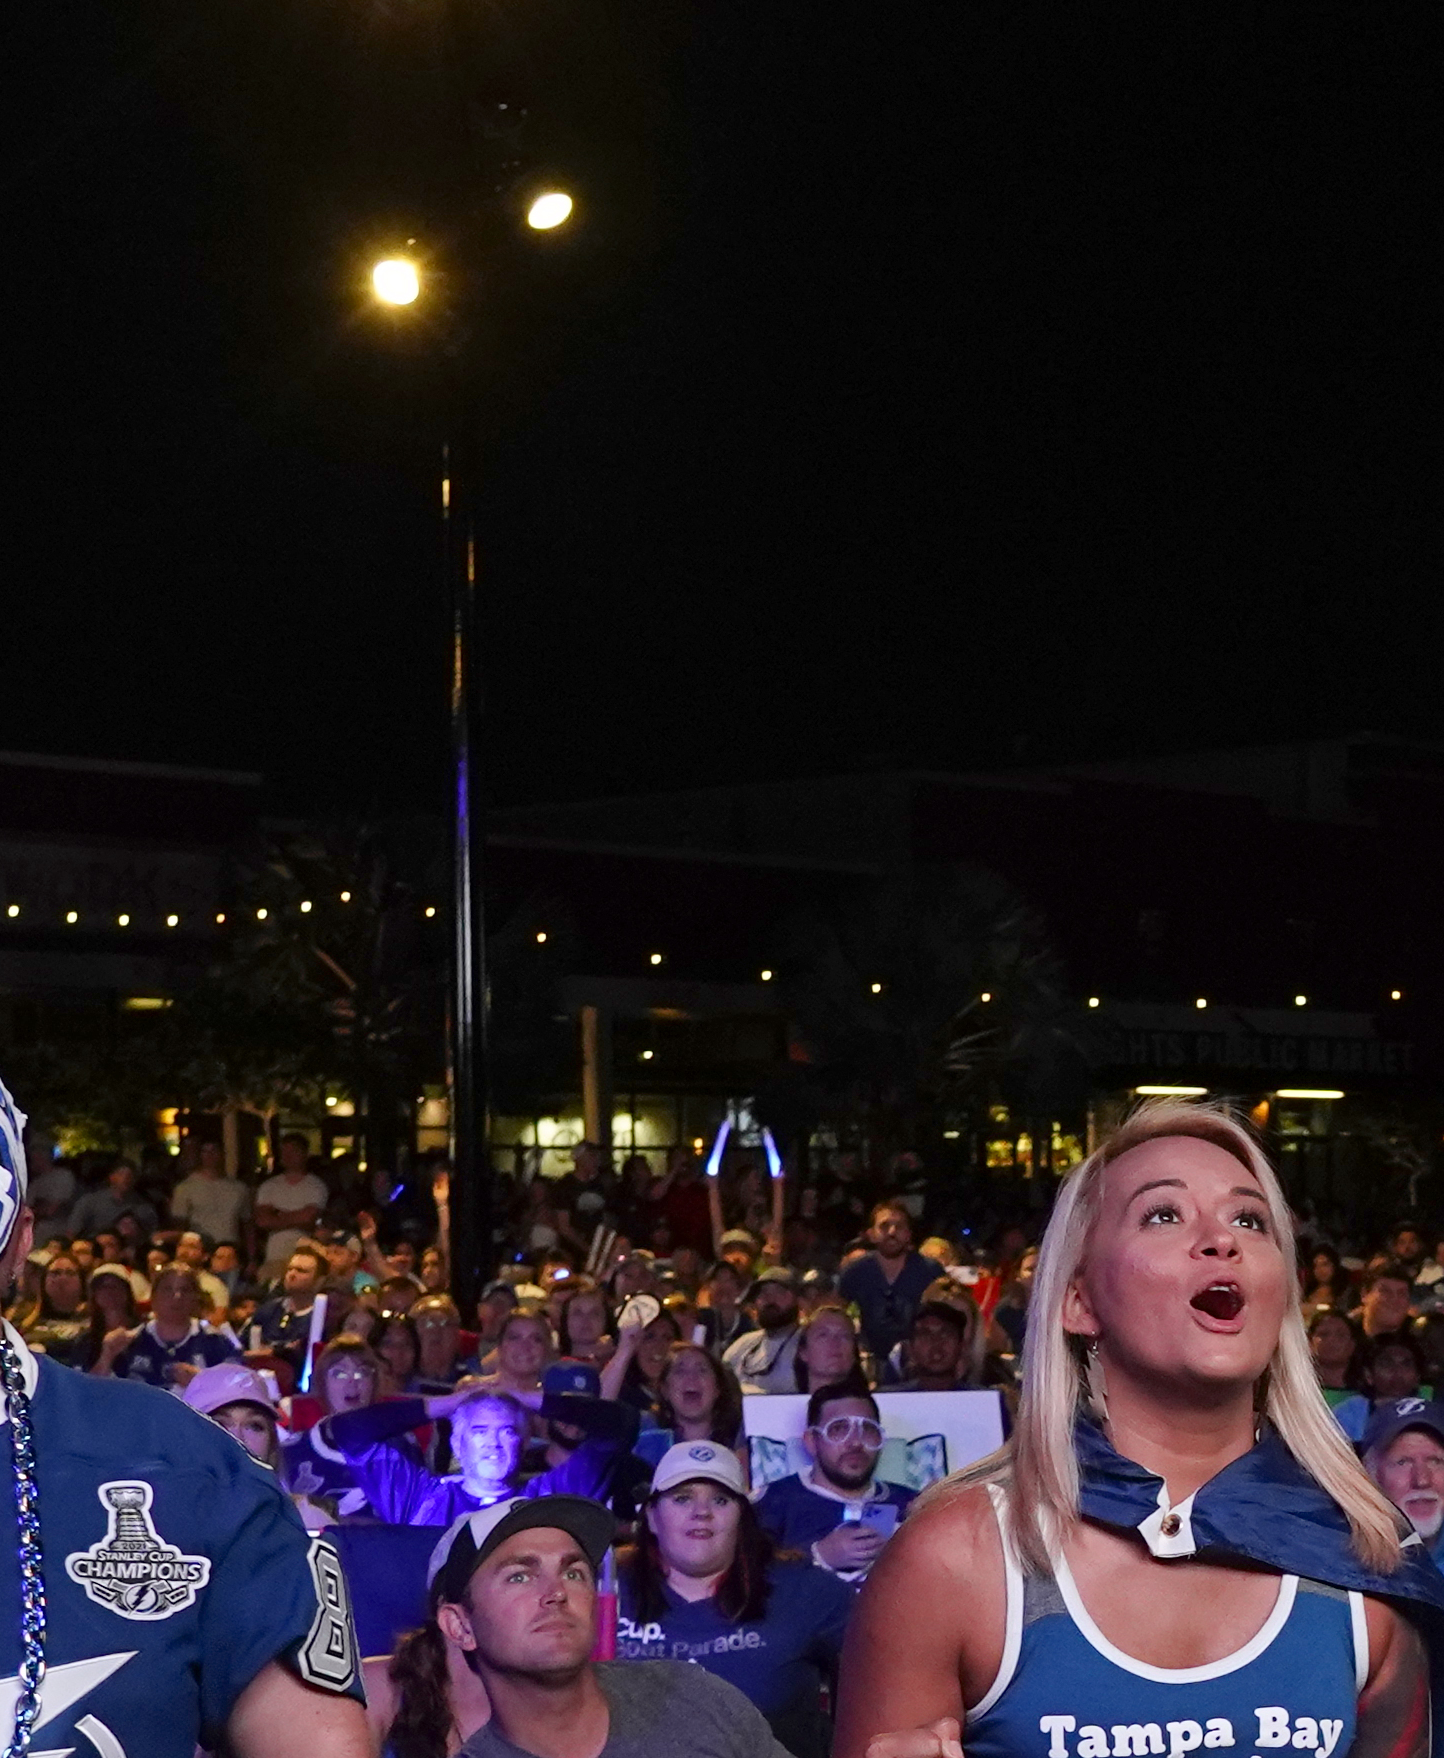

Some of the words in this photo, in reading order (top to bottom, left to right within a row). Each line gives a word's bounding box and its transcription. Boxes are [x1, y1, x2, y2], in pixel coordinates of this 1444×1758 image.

[97, 1551, 147, 1561] STANLEY
[149, 1551, 174, 1561] CUP
[73, 1559, 202, 1581] CHAMPIONS
[298, 1537, 357, 1694] 8
